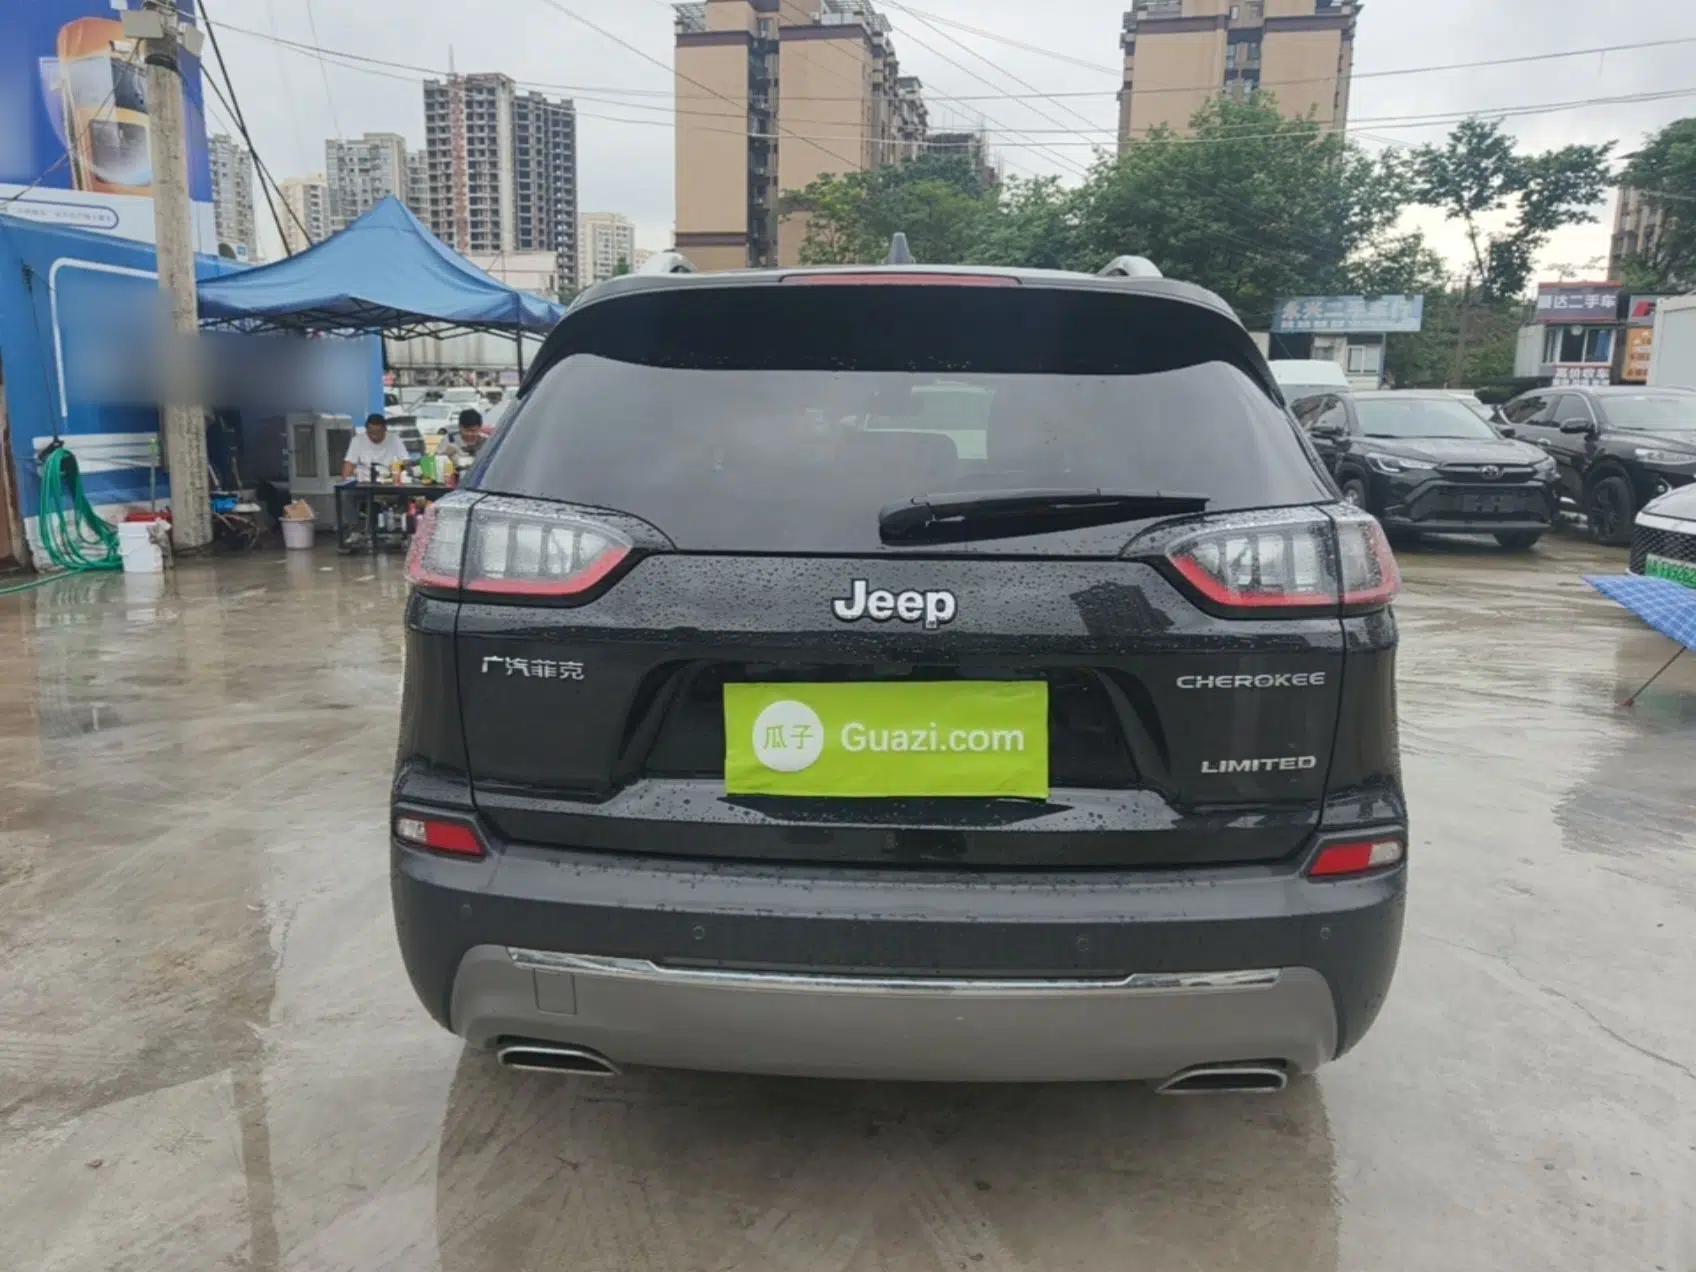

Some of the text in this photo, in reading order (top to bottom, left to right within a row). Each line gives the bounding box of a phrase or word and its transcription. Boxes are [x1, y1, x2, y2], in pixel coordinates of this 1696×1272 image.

[833, 579, 957, 629] Jeep
[481, 655, 585, 680] 广汽菲克
[1176, 671, 1326, 689] CHEROKEE
[763, 724, 814, 751] 瓜子
[840, 721, 1025, 752] Guazi.com
[1201, 755, 1317, 773] LIMITED
